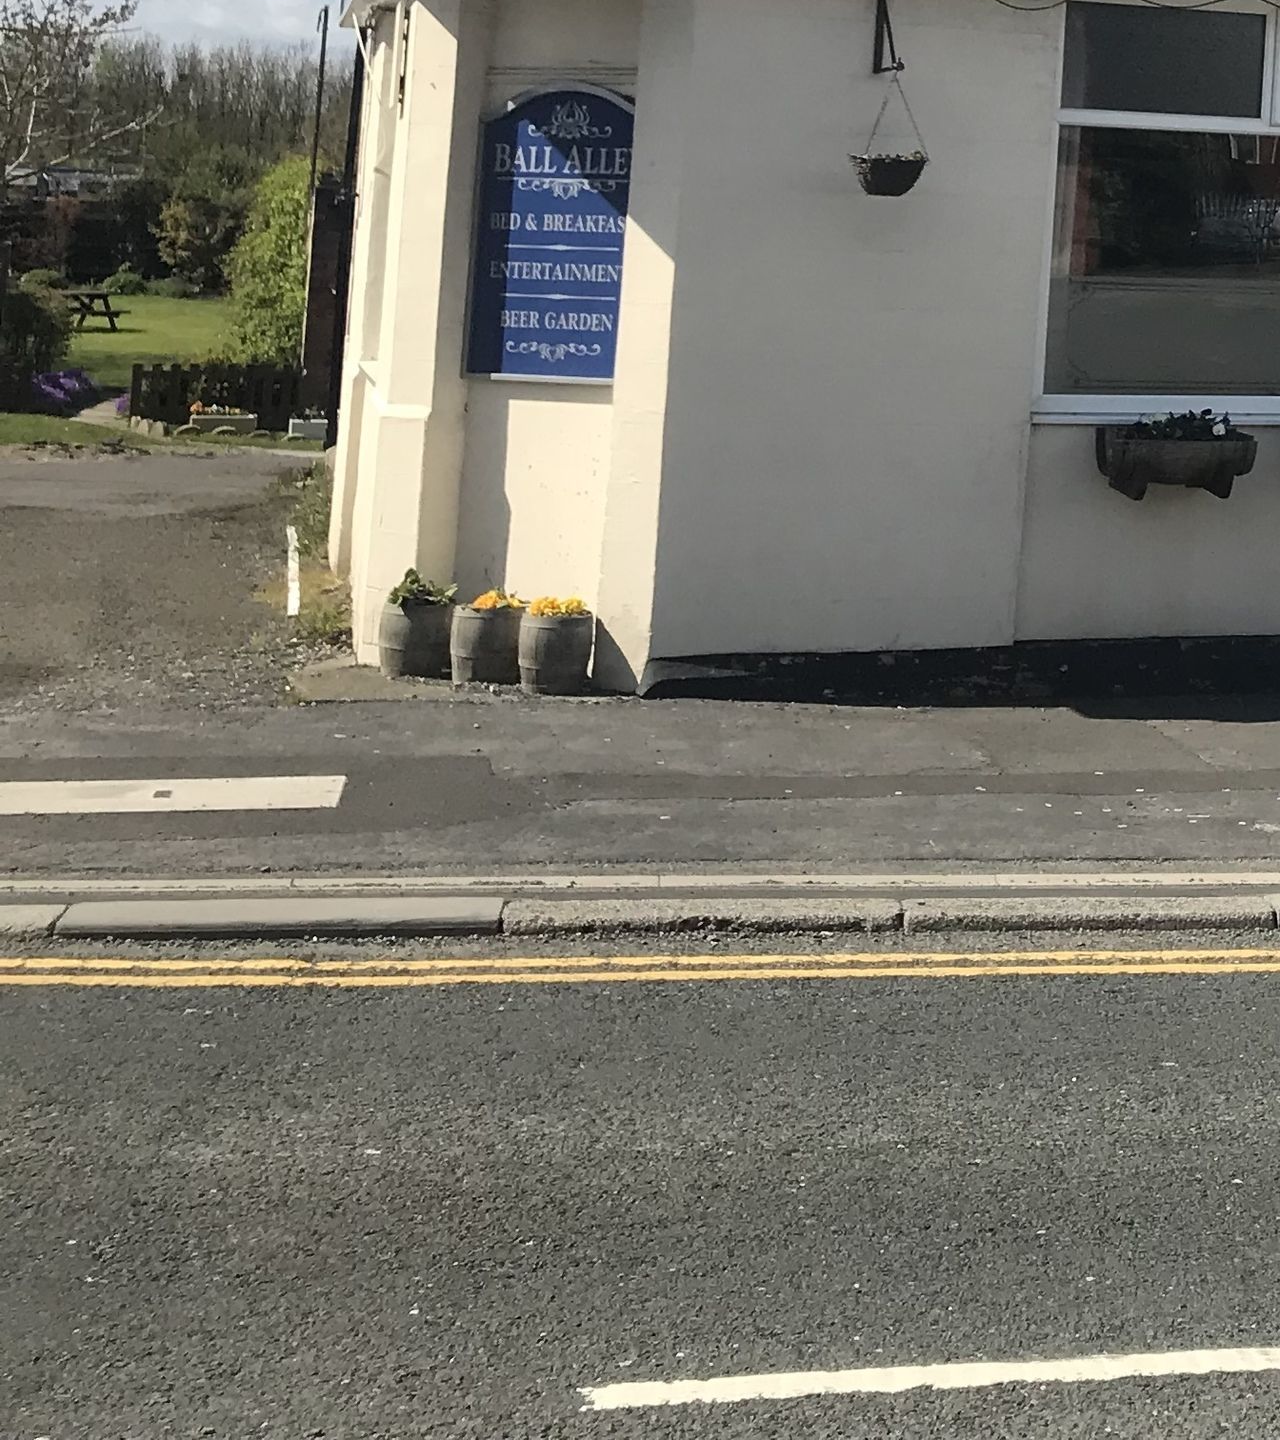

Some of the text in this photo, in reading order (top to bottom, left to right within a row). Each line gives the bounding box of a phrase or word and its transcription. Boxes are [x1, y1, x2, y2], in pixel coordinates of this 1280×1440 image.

[495, 143, 632, 174] BALL ALLE
[490, 212, 626, 233] BED & BREAKFAS
[501, 310, 613, 331] BEER GARDEN
